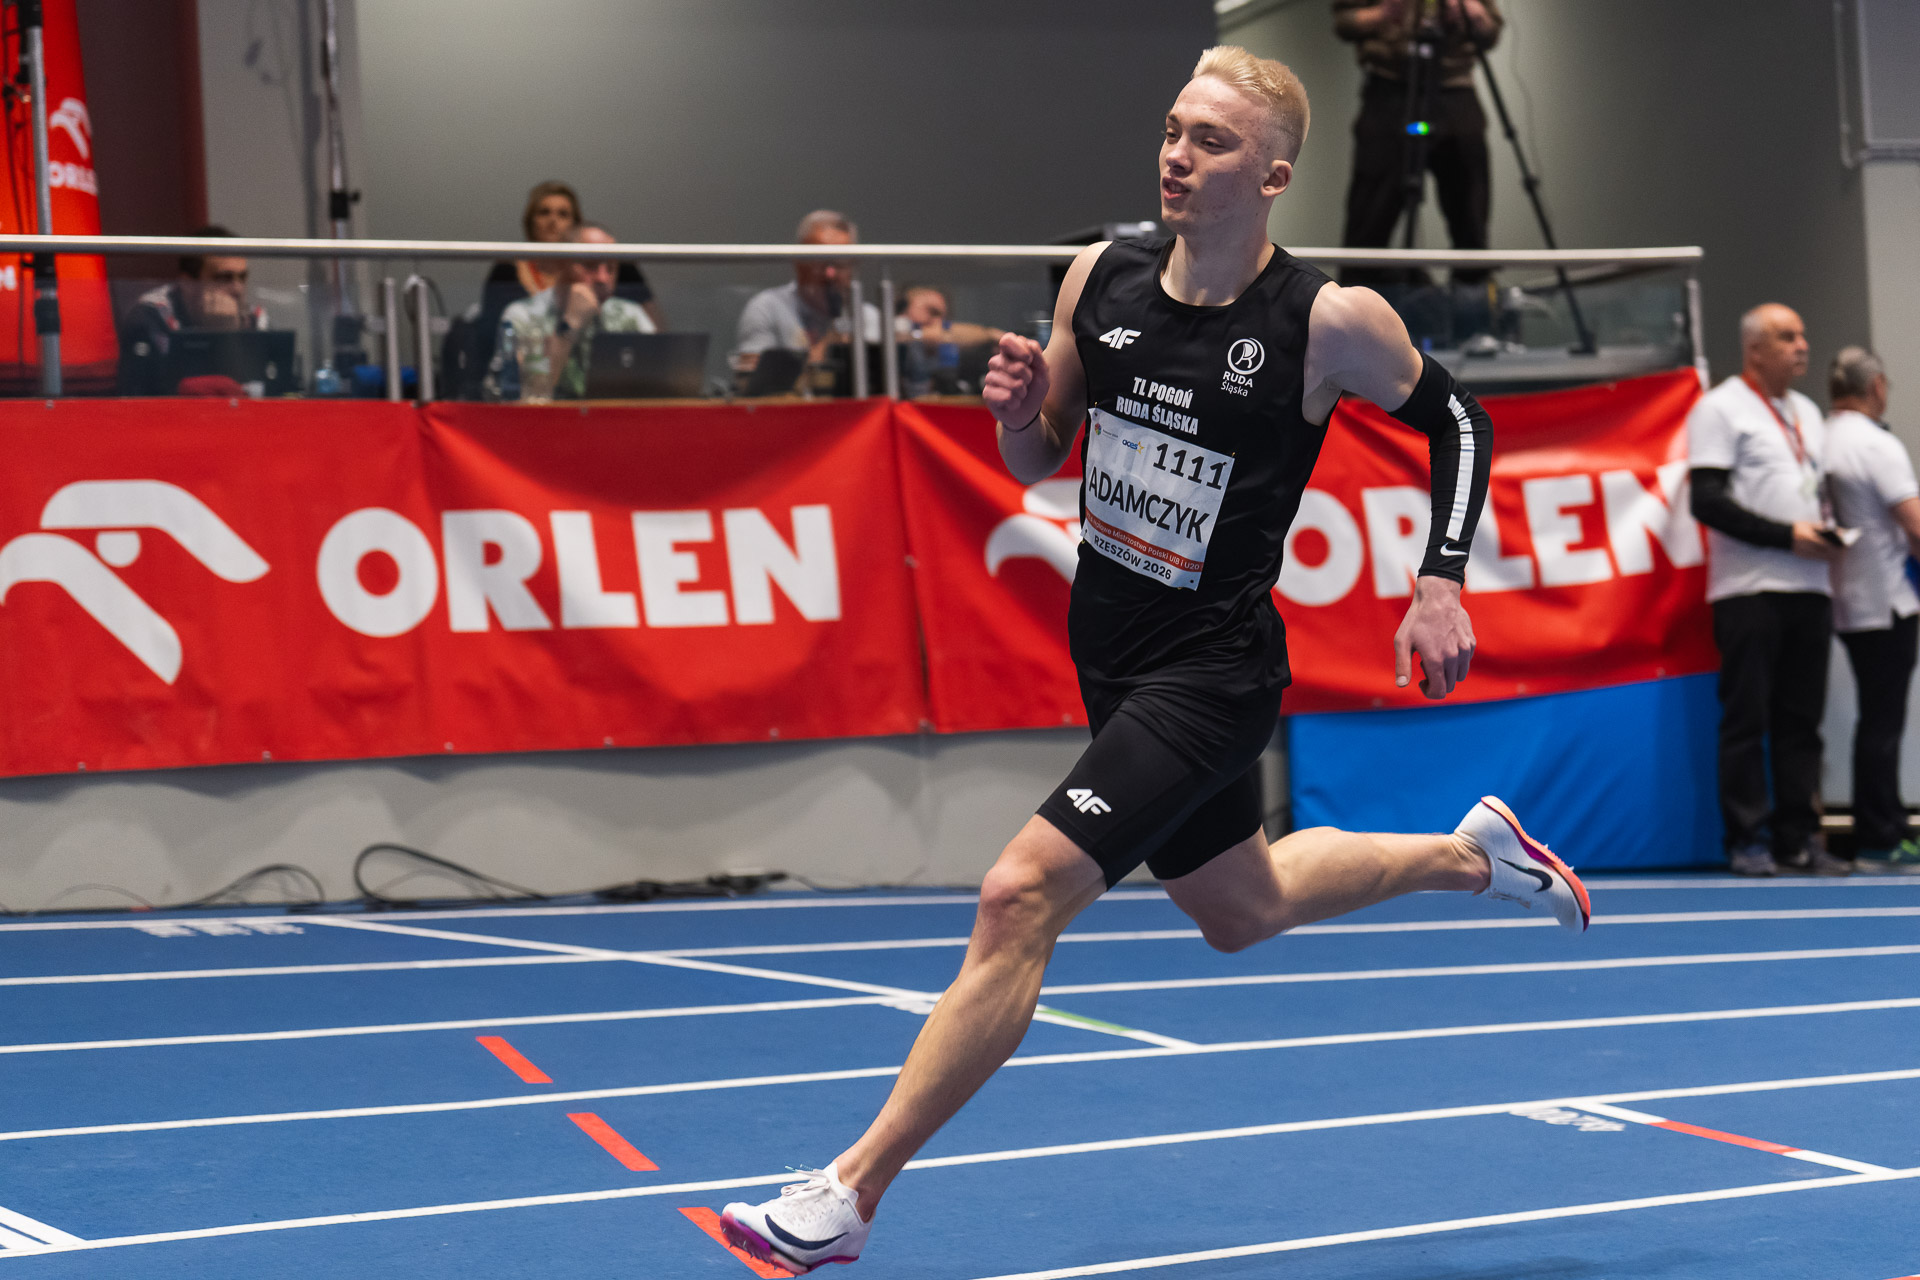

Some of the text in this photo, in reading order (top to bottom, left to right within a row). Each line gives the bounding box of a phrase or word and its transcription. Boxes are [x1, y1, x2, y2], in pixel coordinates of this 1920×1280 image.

[1099, 327, 1142, 350] 4F
[1132, 376, 1194, 409] TL POGOŃ
[1220, 379, 1249, 397] Śląska
[1222, 370, 1254, 388] RUDA
[1115, 395, 1150, 420] RUDA
[1151, 403, 1199, 436] ŚLĄSKA
[1152, 442, 1225, 491] 1111
[1088, 466, 1210, 544] ADAMCZYK
[316, 504, 841, 637] ORLEN
[1094, 535, 1173, 580] RZESZÓW 2026
[1112, 530, 1147, 552] Mistrzostwa
[1147, 547, 1169, 560] Polski
[1184, 562, 1200, 571] U20
[1066, 788, 1112, 815] 4F
